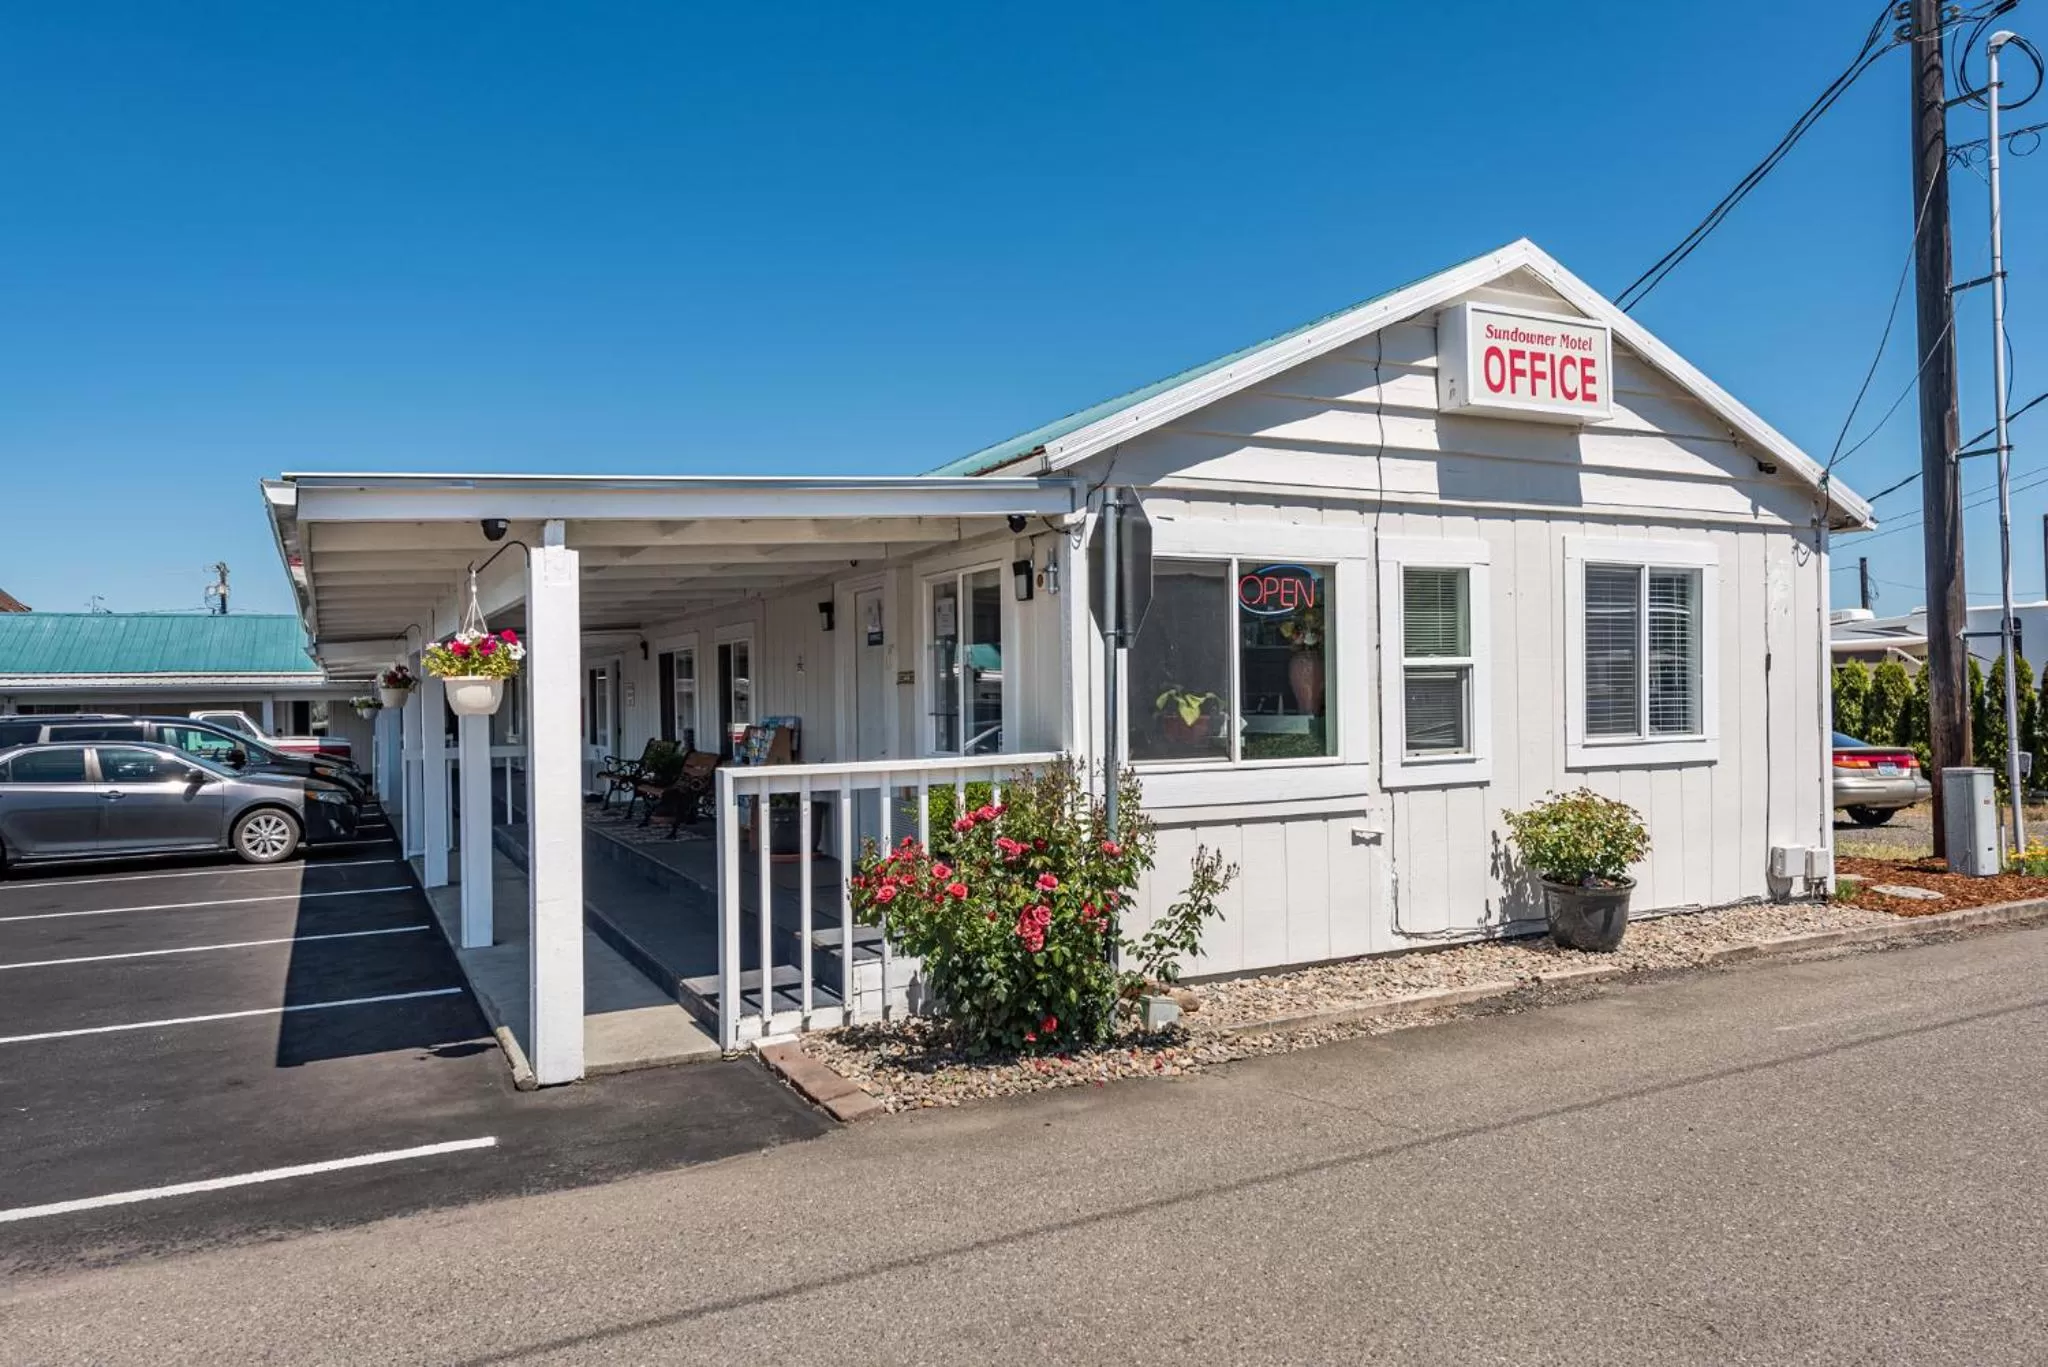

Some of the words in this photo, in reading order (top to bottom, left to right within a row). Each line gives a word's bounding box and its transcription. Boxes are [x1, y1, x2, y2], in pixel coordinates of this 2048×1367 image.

[1485, 324, 1557, 347] Sundowner
[1560, 333, 1593, 351] Motel
[1484, 345, 1598, 403] OFFICE
[1239, 575, 1315, 609] OPEN
